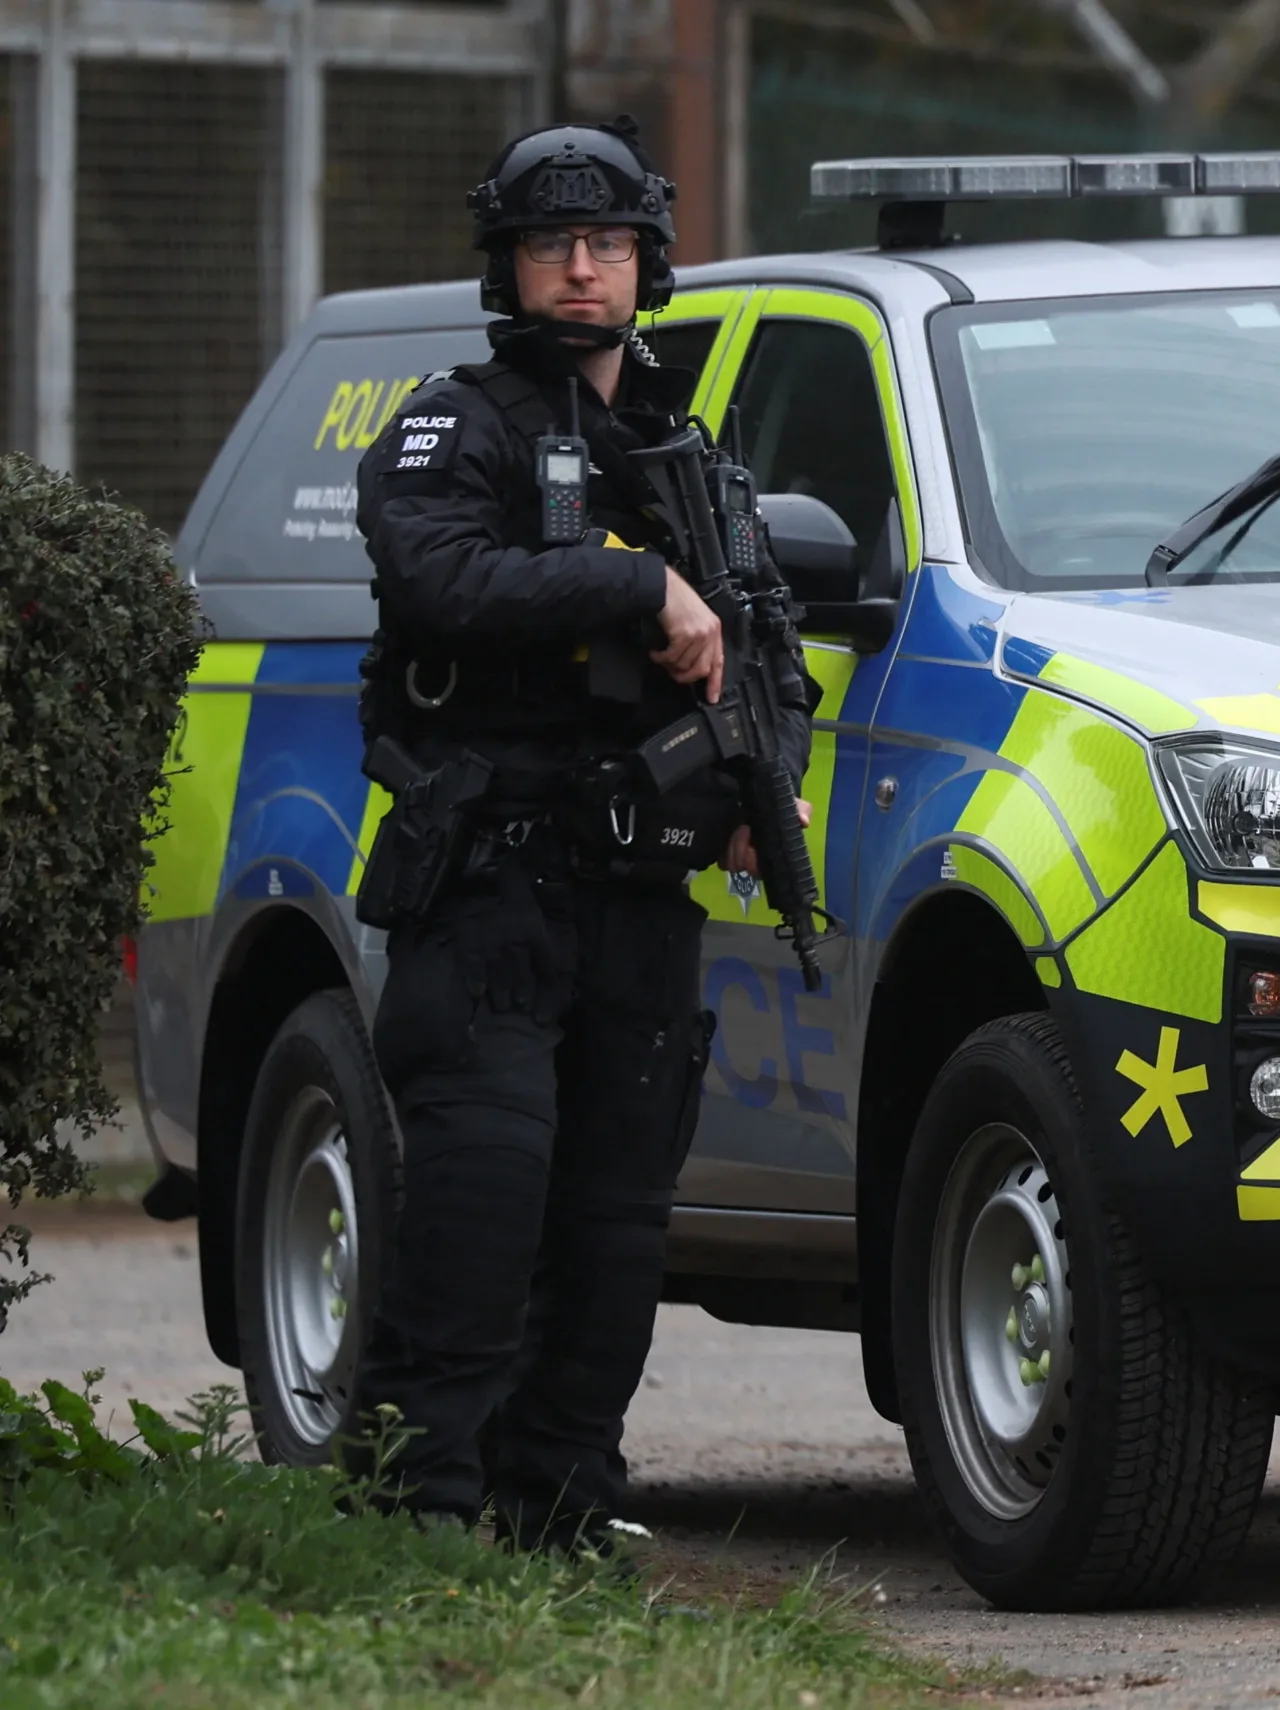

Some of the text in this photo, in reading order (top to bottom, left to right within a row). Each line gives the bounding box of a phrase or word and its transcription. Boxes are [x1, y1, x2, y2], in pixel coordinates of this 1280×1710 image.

[401, 416, 458, 429] POLICE
[402, 433, 439, 452] MD
[397, 455, 431, 468] 3921
[660, 827, 695, 848] 3921
